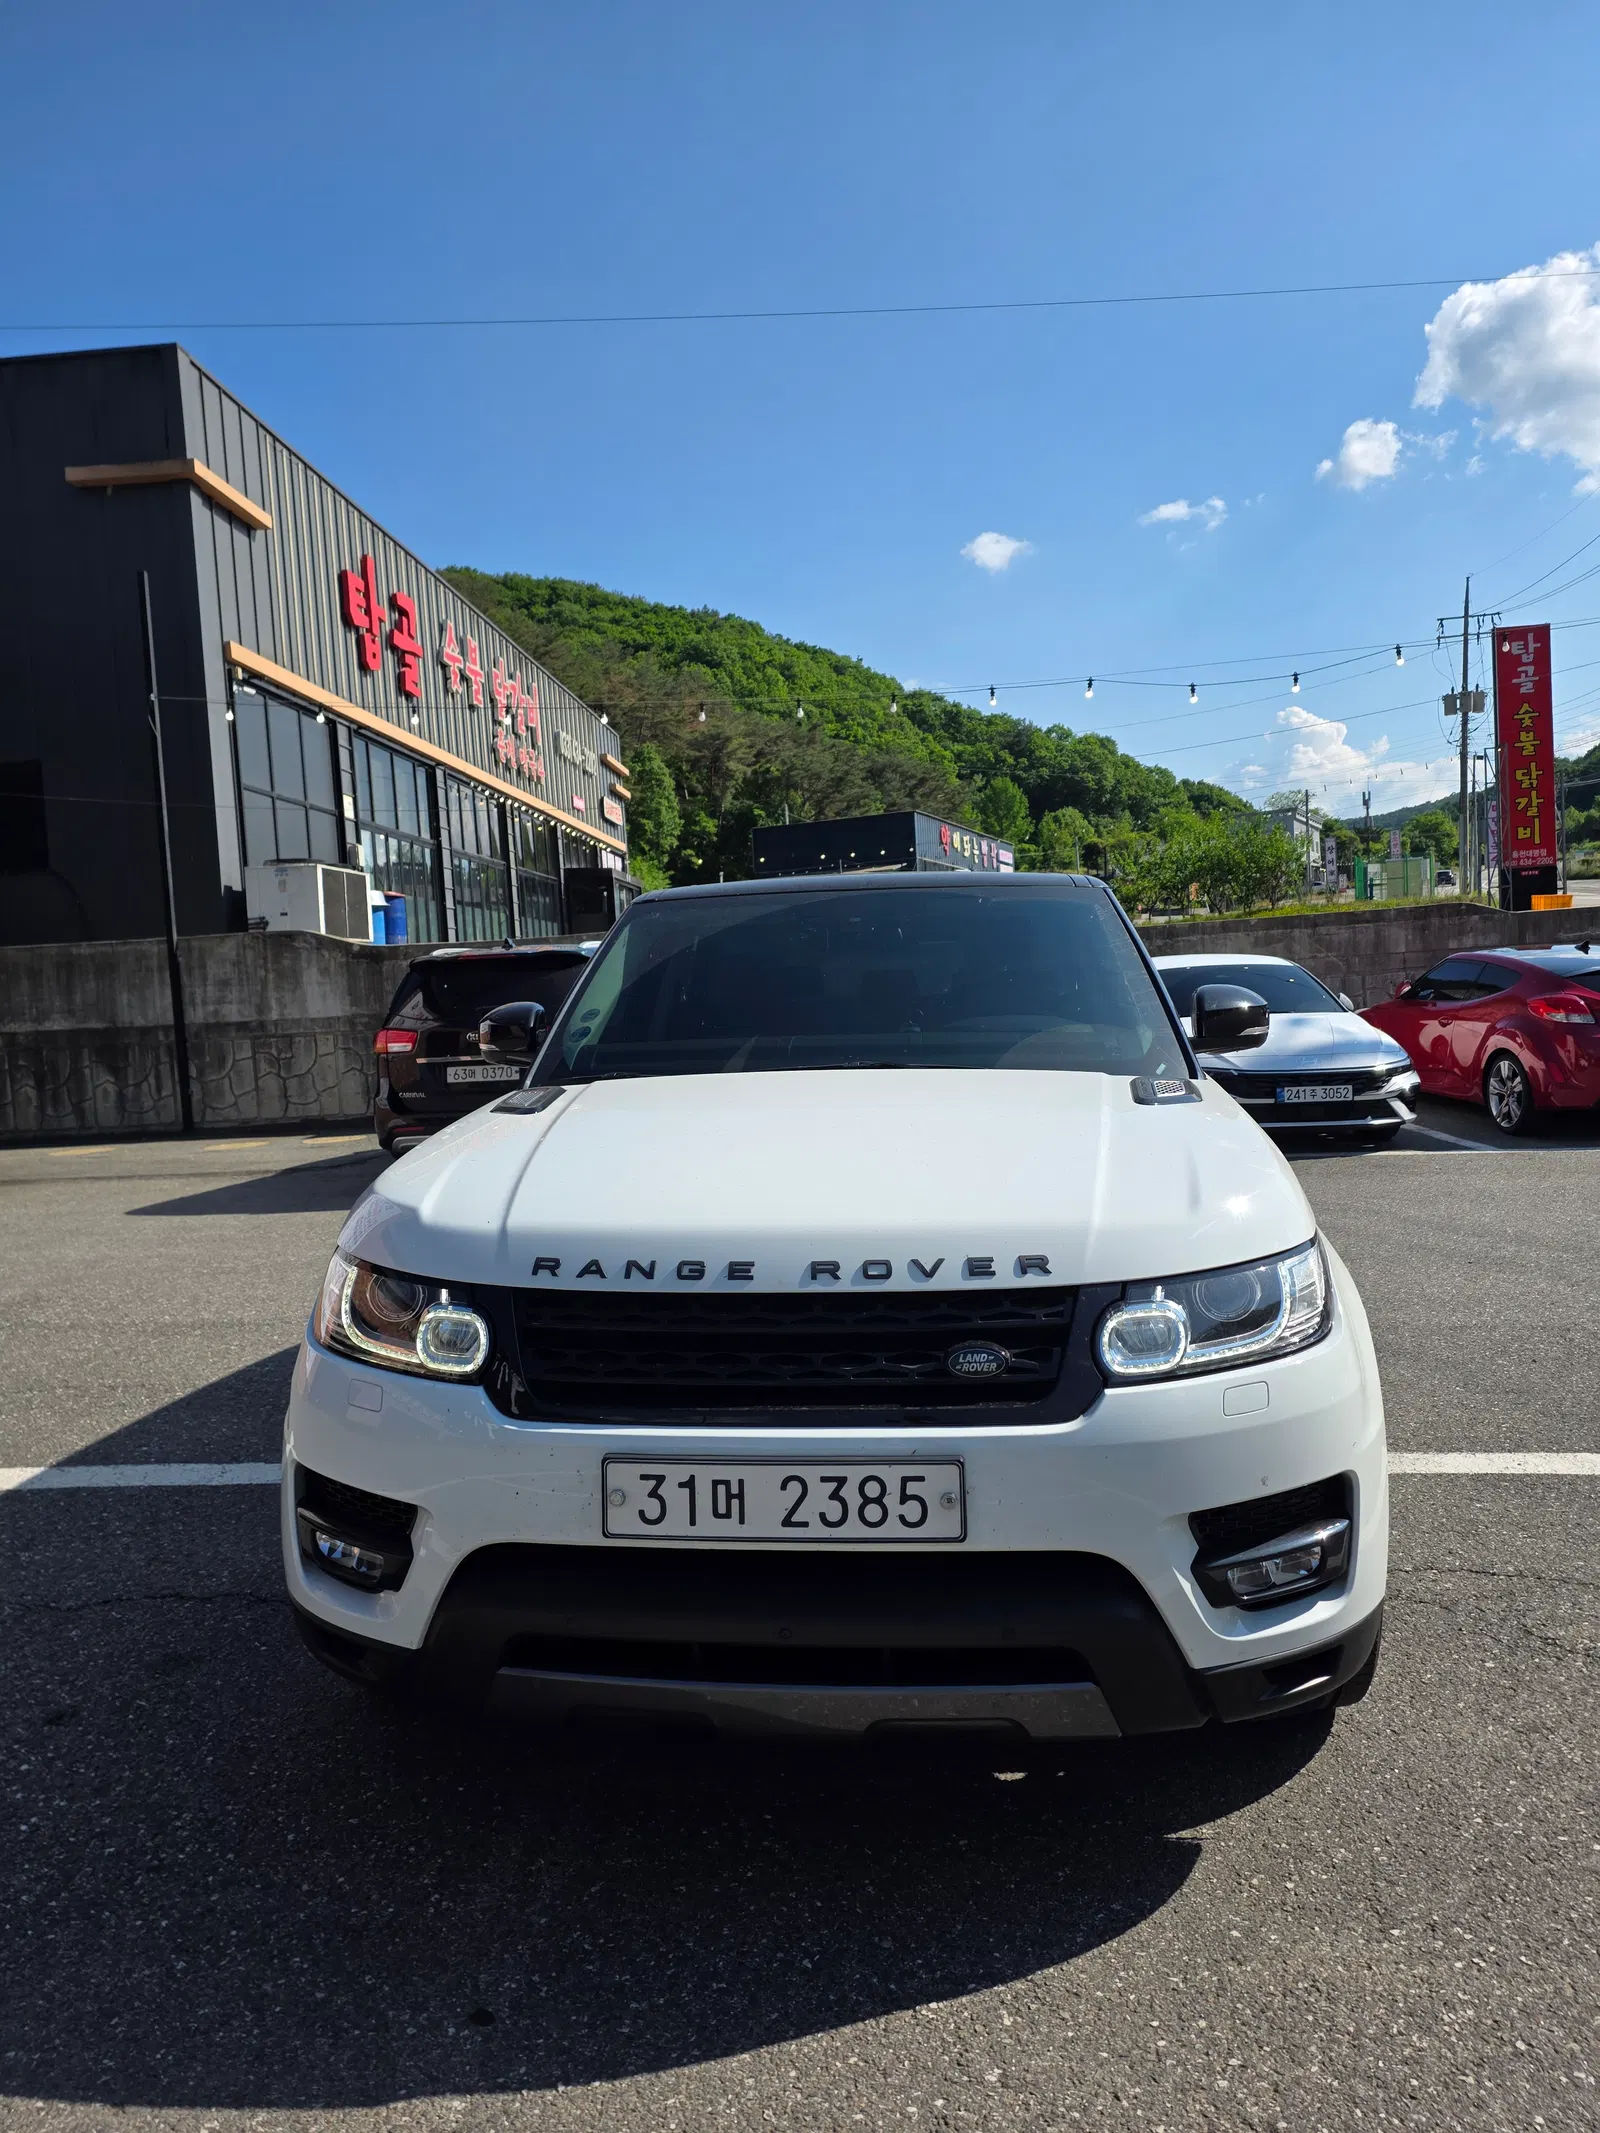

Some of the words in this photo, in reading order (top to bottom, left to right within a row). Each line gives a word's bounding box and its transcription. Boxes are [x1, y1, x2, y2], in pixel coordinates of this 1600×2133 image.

[341, 554, 424, 698] 탑골
[440, 618, 484, 708] 숯불
[489, 656, 541, 746] 닭갈비
[1511, 632, 1541, 694] 탑골
[1513, 702, 1541, 756] 숯불
[1515, 762, 1544, 845] 닭갈비
[453, 1068, 476, 1081] 63머
[481, 1066, 513, 1079] 0370
[1286, 1088, 1318, 1101] 241주
[1320, 1086, 1350, 1100] 3052
[531, 1256, 756, 1282] RANGE
[810, 1254, 1054, 1281] ROVER
[958, 1353, 988, 1363] LAND
[961, 1362, 997, 1372] ROVER
[637, 1473, 746, 1527] 31머
[780, 1474, 930, 1530] 2385
